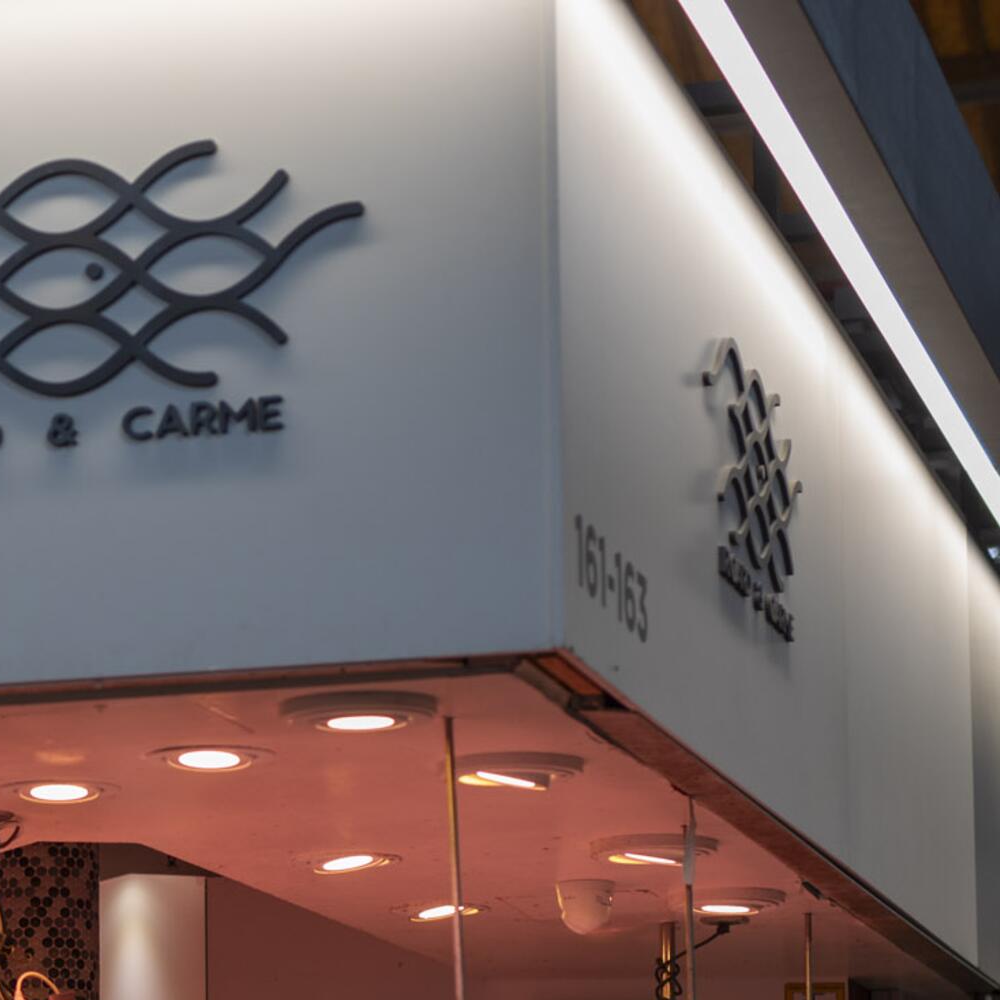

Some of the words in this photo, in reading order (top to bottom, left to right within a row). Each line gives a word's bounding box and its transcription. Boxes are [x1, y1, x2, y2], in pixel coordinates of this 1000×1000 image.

[47, 413, 78, 448] &
[122, 396, 284, 442] CARME
[575, 514, 648, 642] 161-163
